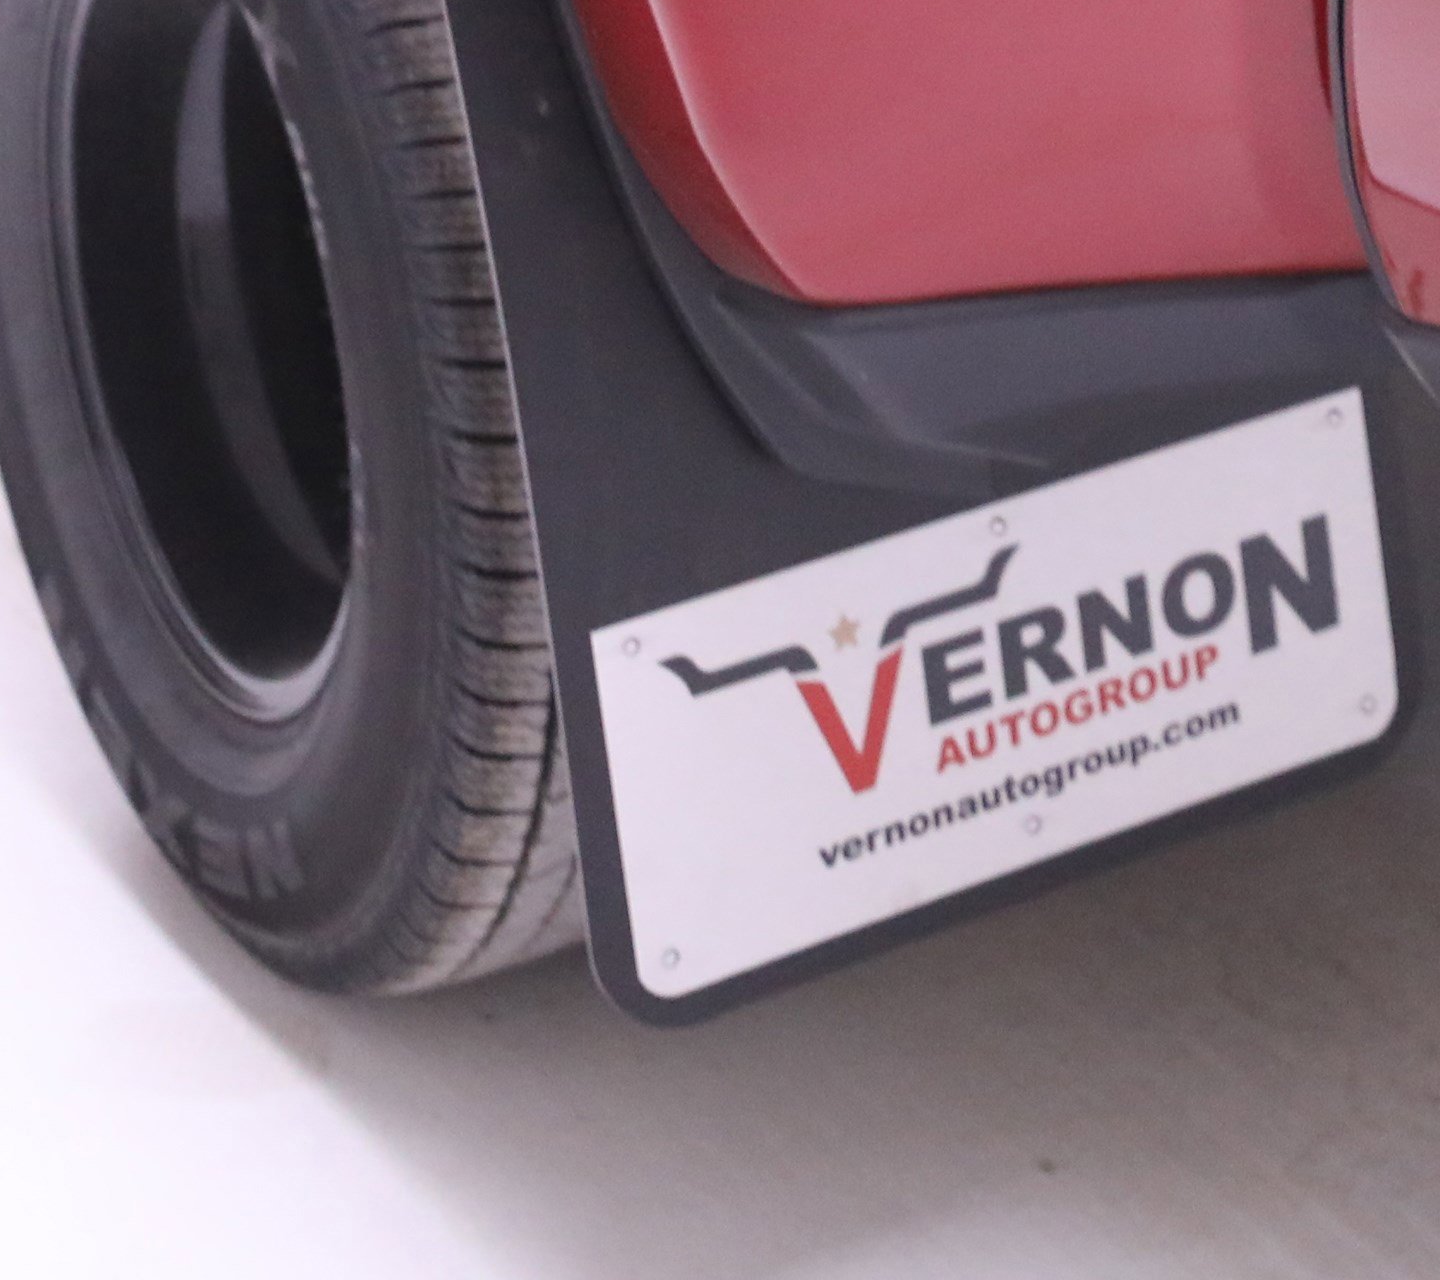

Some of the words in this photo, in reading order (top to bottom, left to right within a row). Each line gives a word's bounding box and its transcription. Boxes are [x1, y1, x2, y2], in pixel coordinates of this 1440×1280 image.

[798, 513, 1341, 794] VERNON
[935, 643, 1222, 774] AUTOGROUP
[818, 697, 1241, 871] vernonautogroup.com
